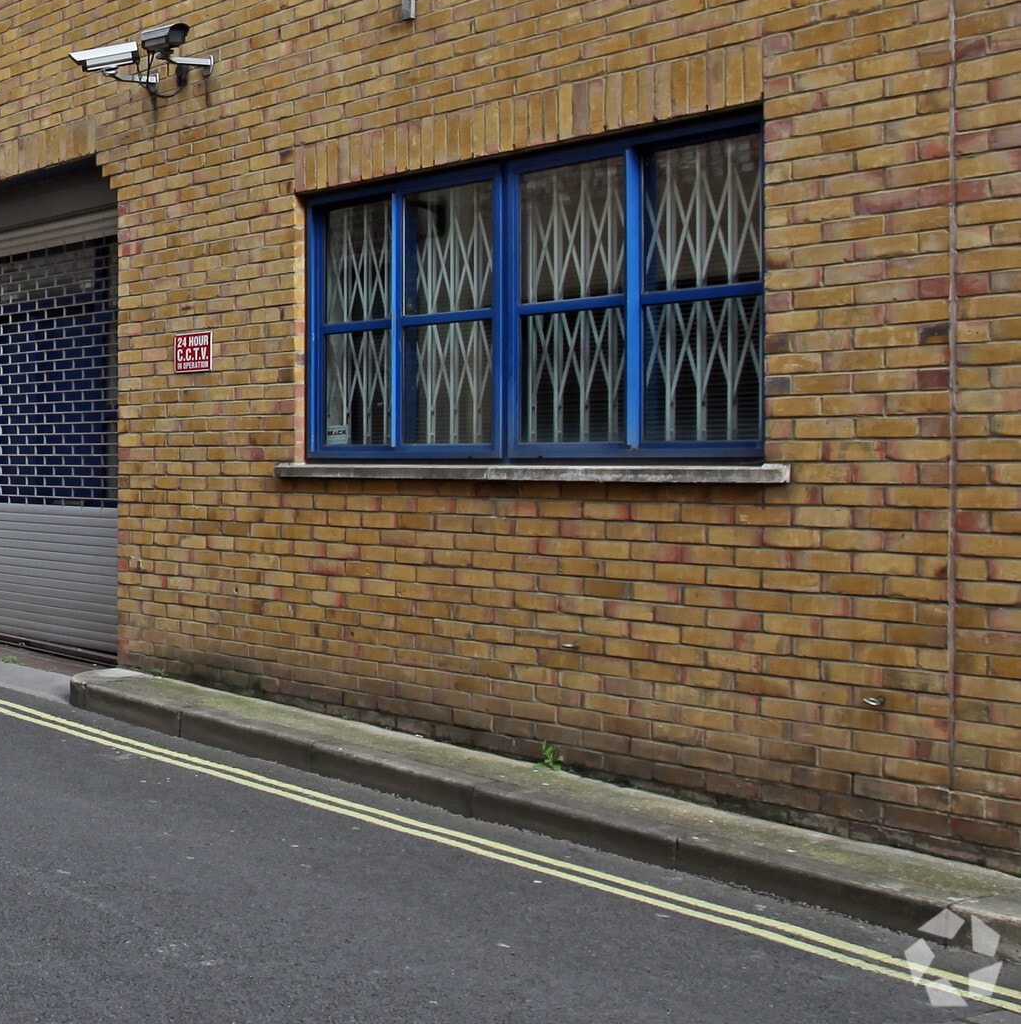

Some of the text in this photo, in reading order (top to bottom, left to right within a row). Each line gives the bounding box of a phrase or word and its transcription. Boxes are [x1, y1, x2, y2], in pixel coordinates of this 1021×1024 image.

[177, 335, 208, 347] 24 HOUR
[177, 347, 208, 361] C.C.T.V.
[183, 361, 208, 369] OPERATION
